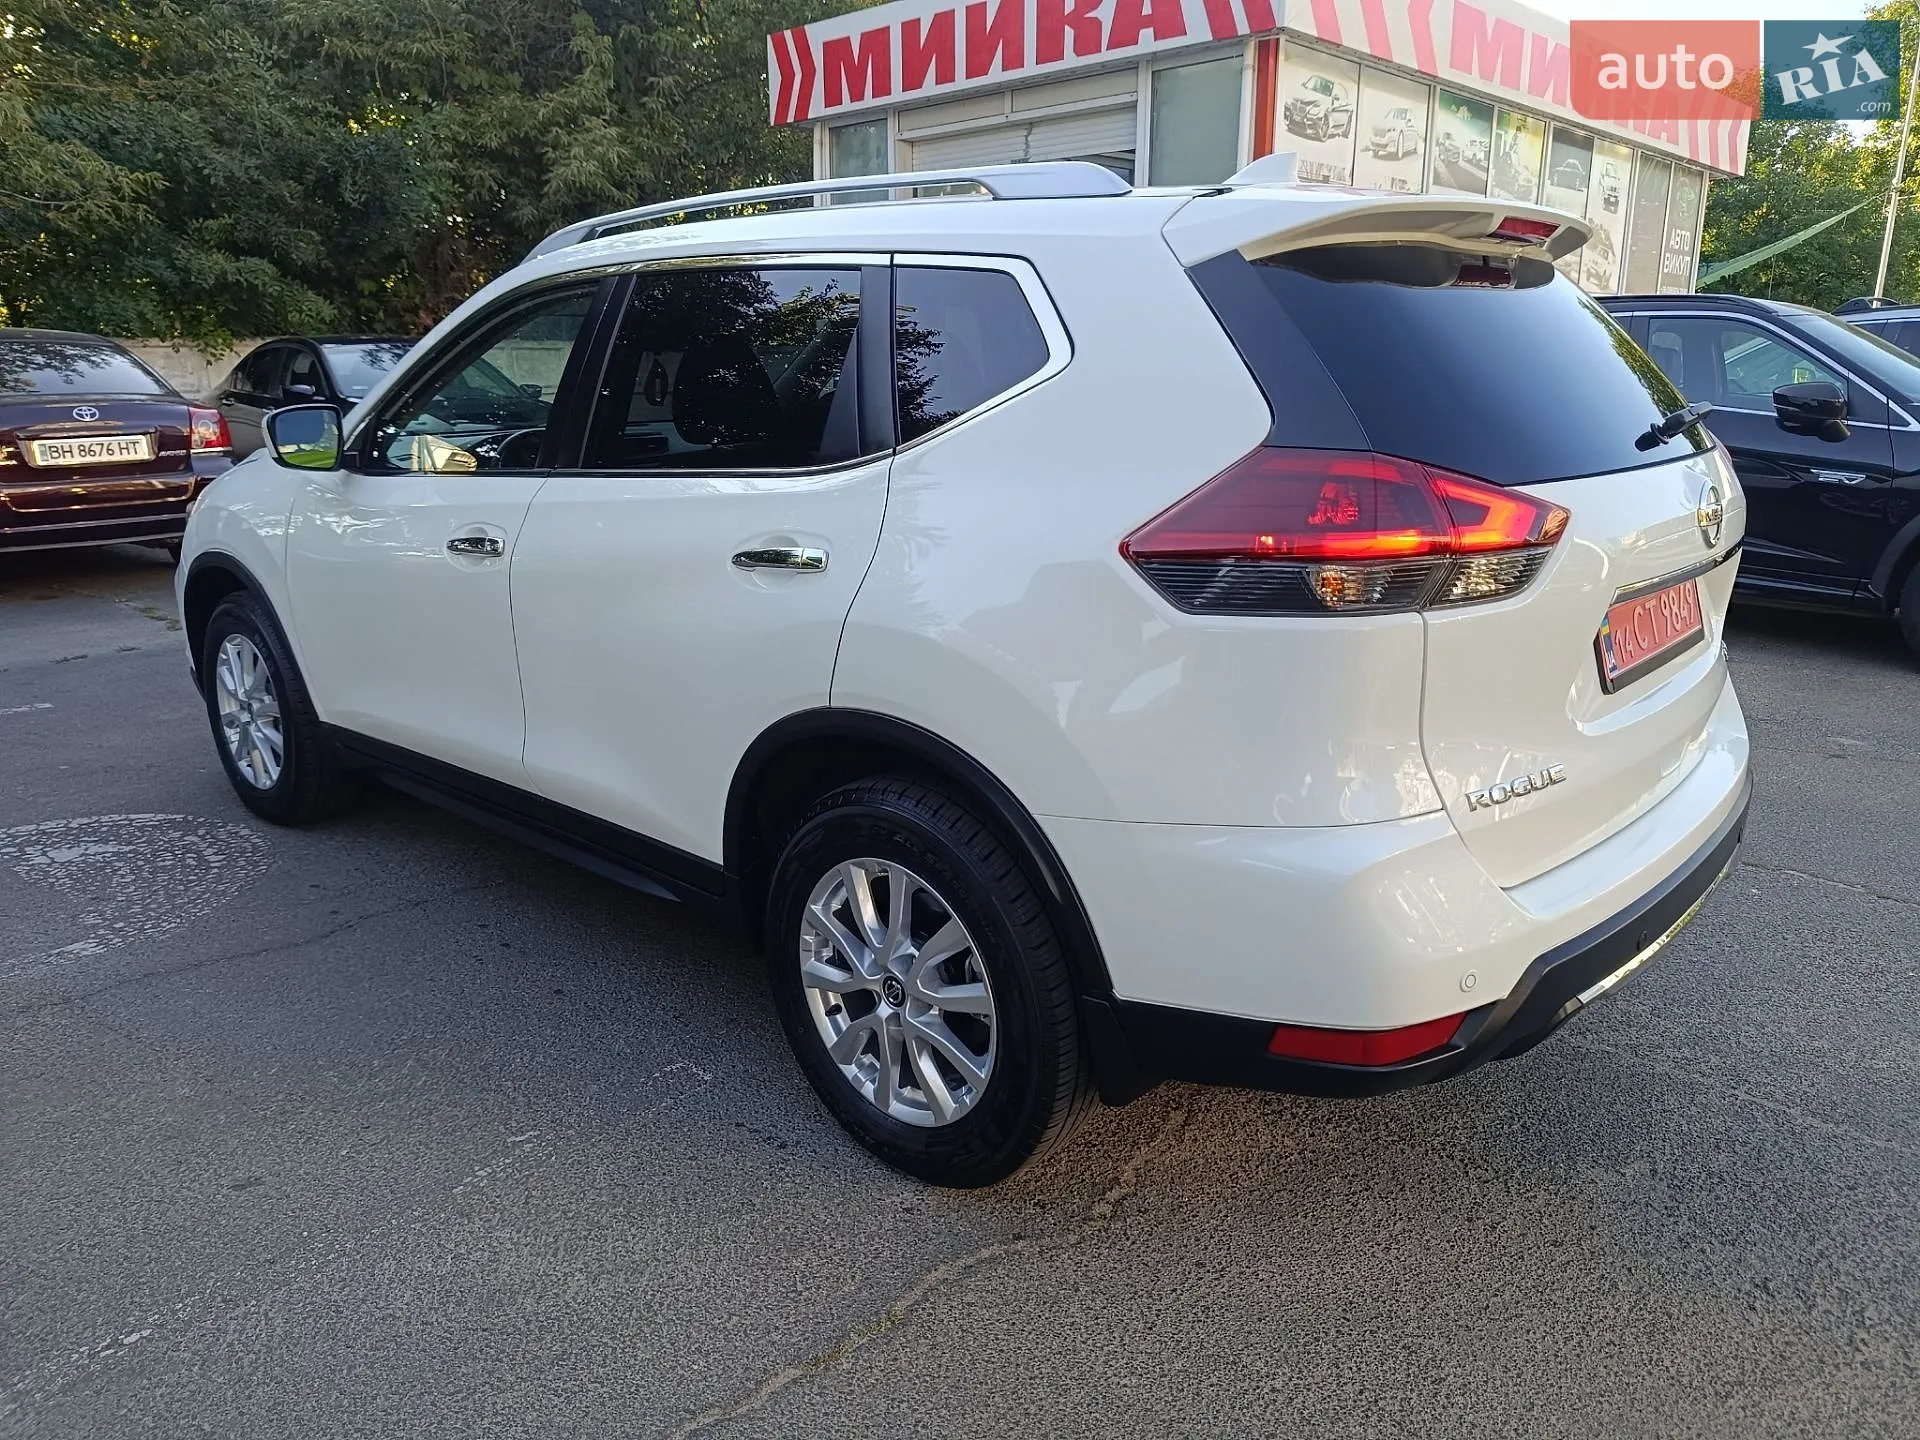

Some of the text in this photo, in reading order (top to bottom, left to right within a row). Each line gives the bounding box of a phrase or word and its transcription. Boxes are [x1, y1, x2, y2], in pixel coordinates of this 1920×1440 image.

[1669, 228, 1691, 252] АВТО
[1663, 252, 1691, 277] ВИКУП
[48, 444, 74, 460] BH
[78, 442, 115, 458] 8676
[118, 441, 140, 456] HT
[1633, 599, 1658, 651] CT
[1660, 582, 1695, 638] 9849
[1465, 763, 1567, 812] ROGUE
